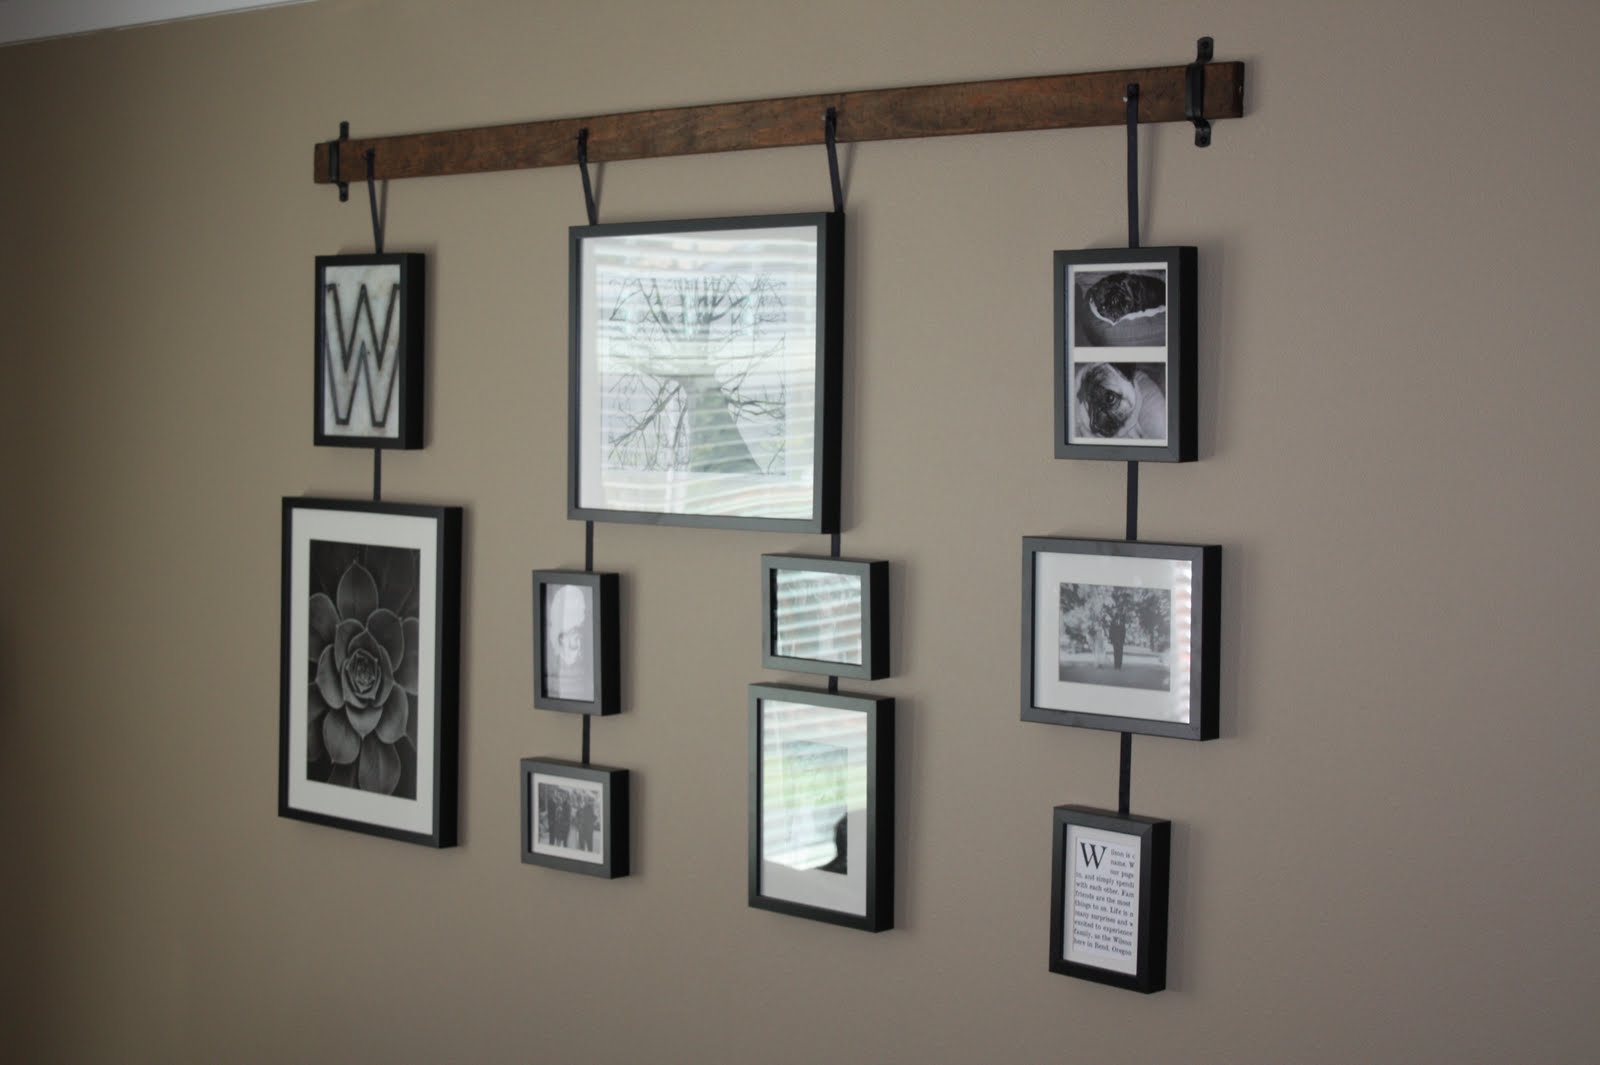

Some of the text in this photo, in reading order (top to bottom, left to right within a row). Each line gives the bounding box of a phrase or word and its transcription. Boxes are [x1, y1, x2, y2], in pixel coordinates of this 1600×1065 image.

[325, 284, 400, 427] W
[1080, 842, 1108, 869] W
[1096, 876, 1114, 886] simply
[1075, 890, 1094, 900] friends
[1074, 900, 1091, 910] things
[1110, 906, 1121, 914] Life
[1091, 913, 1116, 923] surprises
[1103, 926, 1133, 936] experience
[1087, 940, 1093, 948] in
